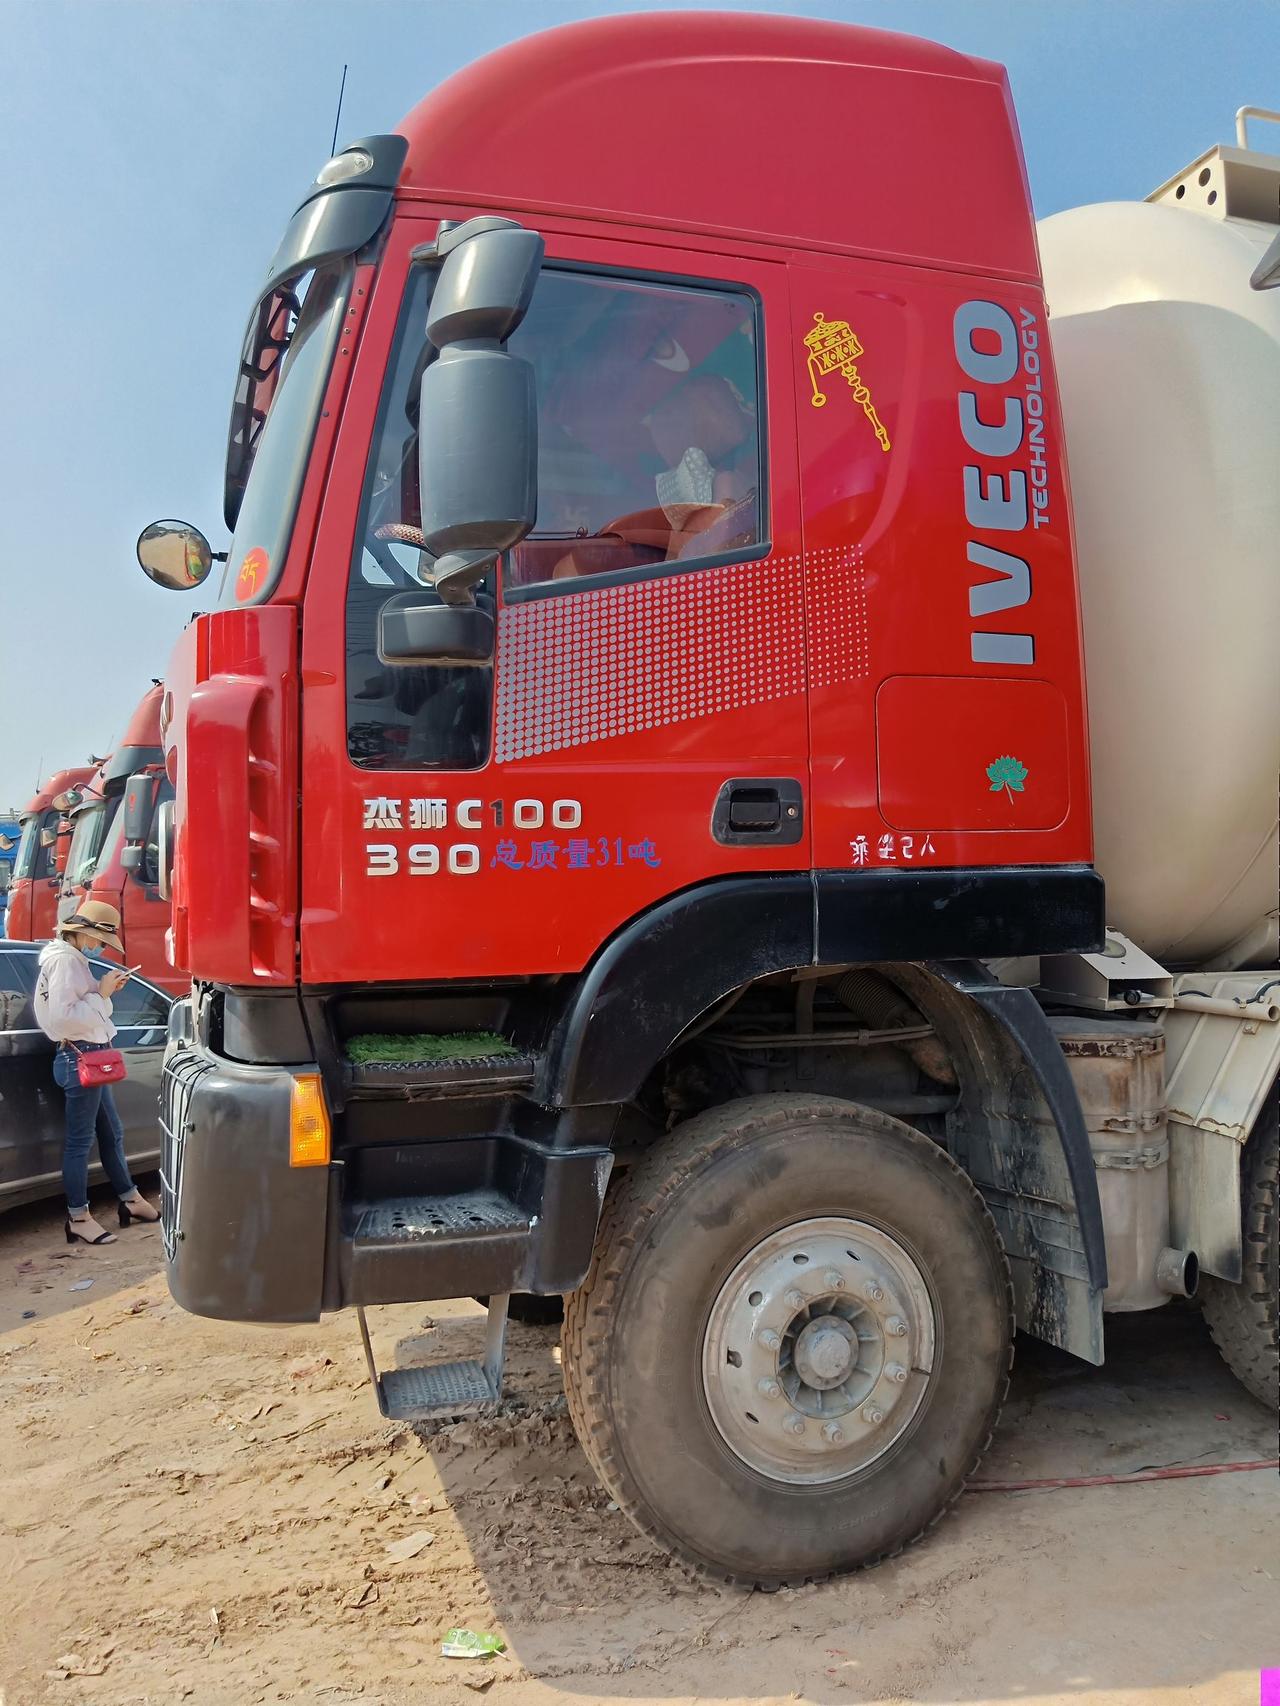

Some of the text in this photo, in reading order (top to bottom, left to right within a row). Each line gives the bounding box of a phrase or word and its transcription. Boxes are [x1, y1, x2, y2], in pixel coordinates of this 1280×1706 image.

[1019, 307, 1049, 529] TECHNOLOGY
[953, 300, 1034, 665] IVECO
[366, 843, 481, 876] 390
[490, 837, 662, 870] 总质量31吨
